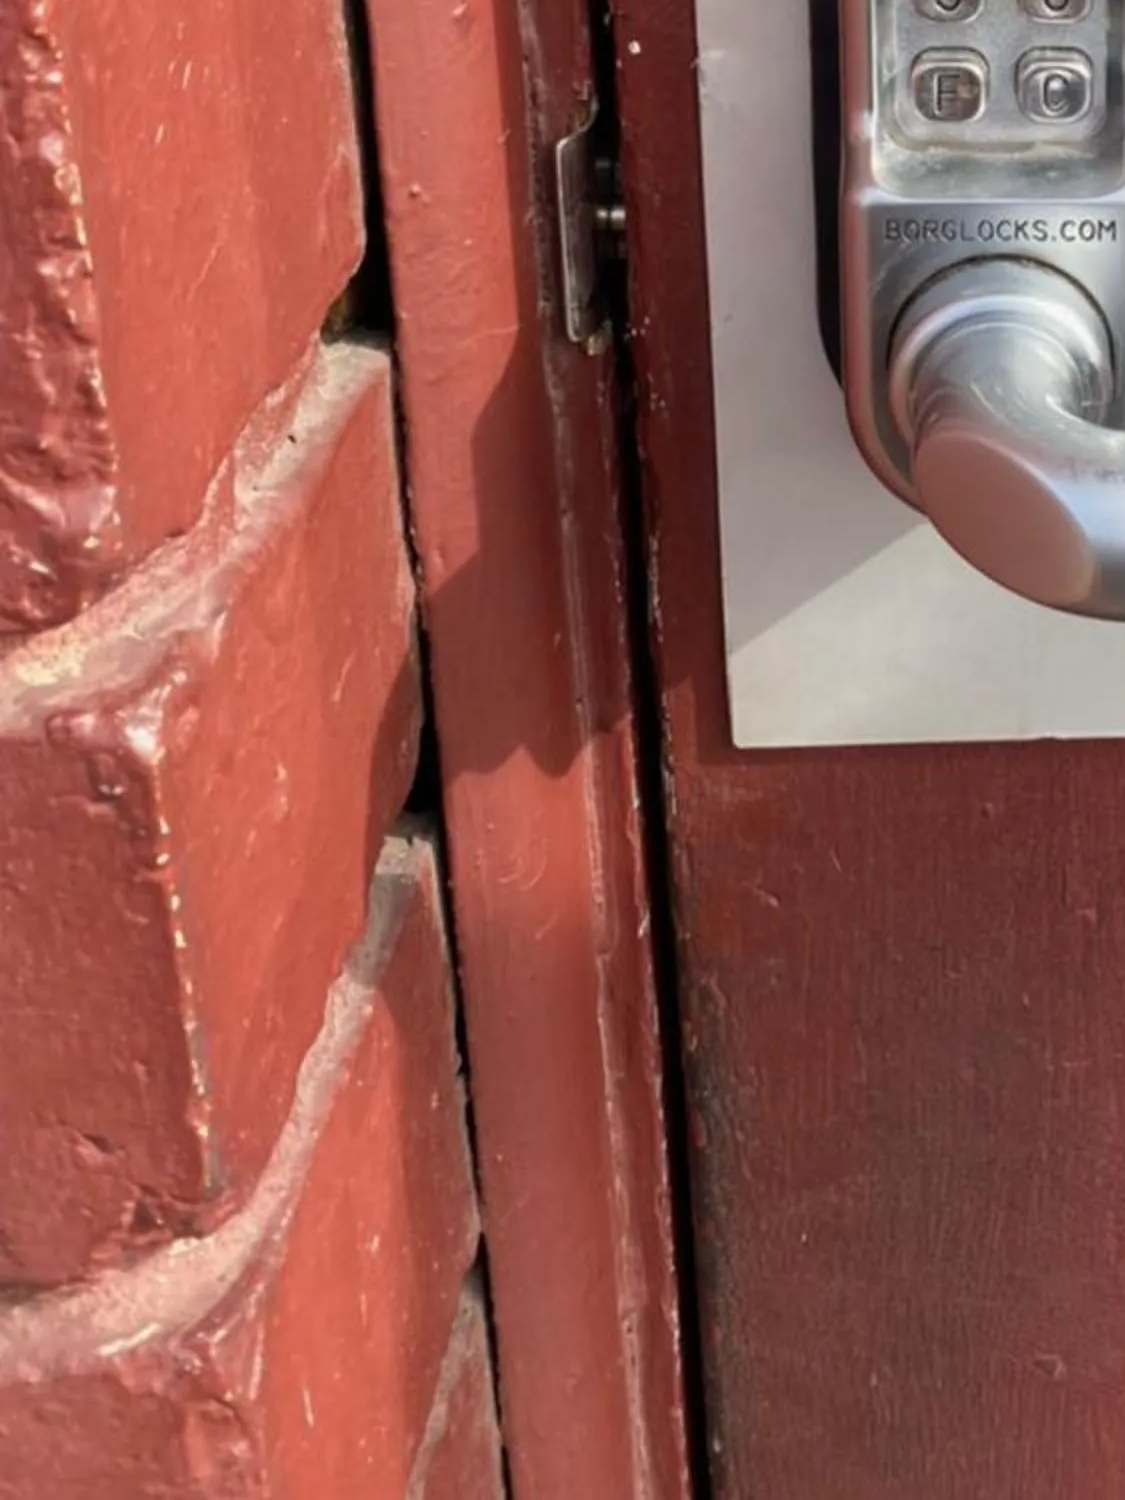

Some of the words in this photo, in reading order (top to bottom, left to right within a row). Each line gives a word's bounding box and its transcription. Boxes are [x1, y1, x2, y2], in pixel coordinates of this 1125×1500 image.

[934, 73, 961, 115] F
[1042, 73, 1071, 114] C
[884, 218, 1118, 242] BORGLOCKS.COM
